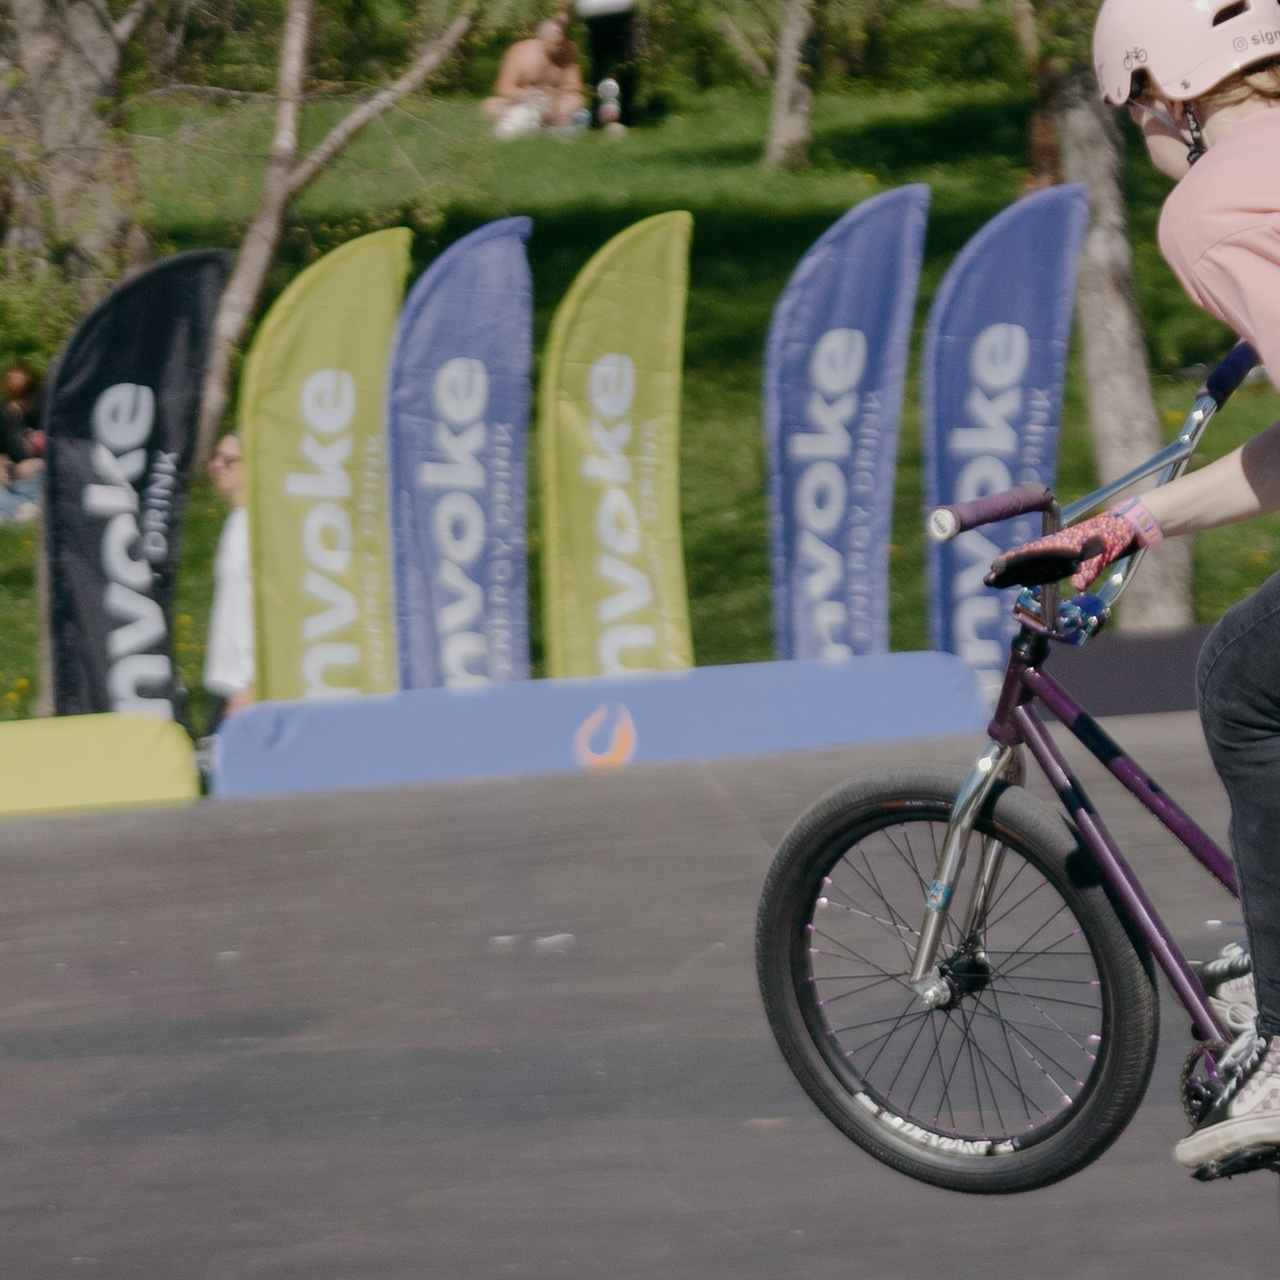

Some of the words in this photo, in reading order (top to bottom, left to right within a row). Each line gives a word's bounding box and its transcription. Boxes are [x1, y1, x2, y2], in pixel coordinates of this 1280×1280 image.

[82, 382, 174, 717] nvoke
[286, 368, 361, 698] nvoke
[417, 357, 490, 687] nvoke
[581, 353, 656, 675] nvoke
[786, 326, 868, 660] nvoke
